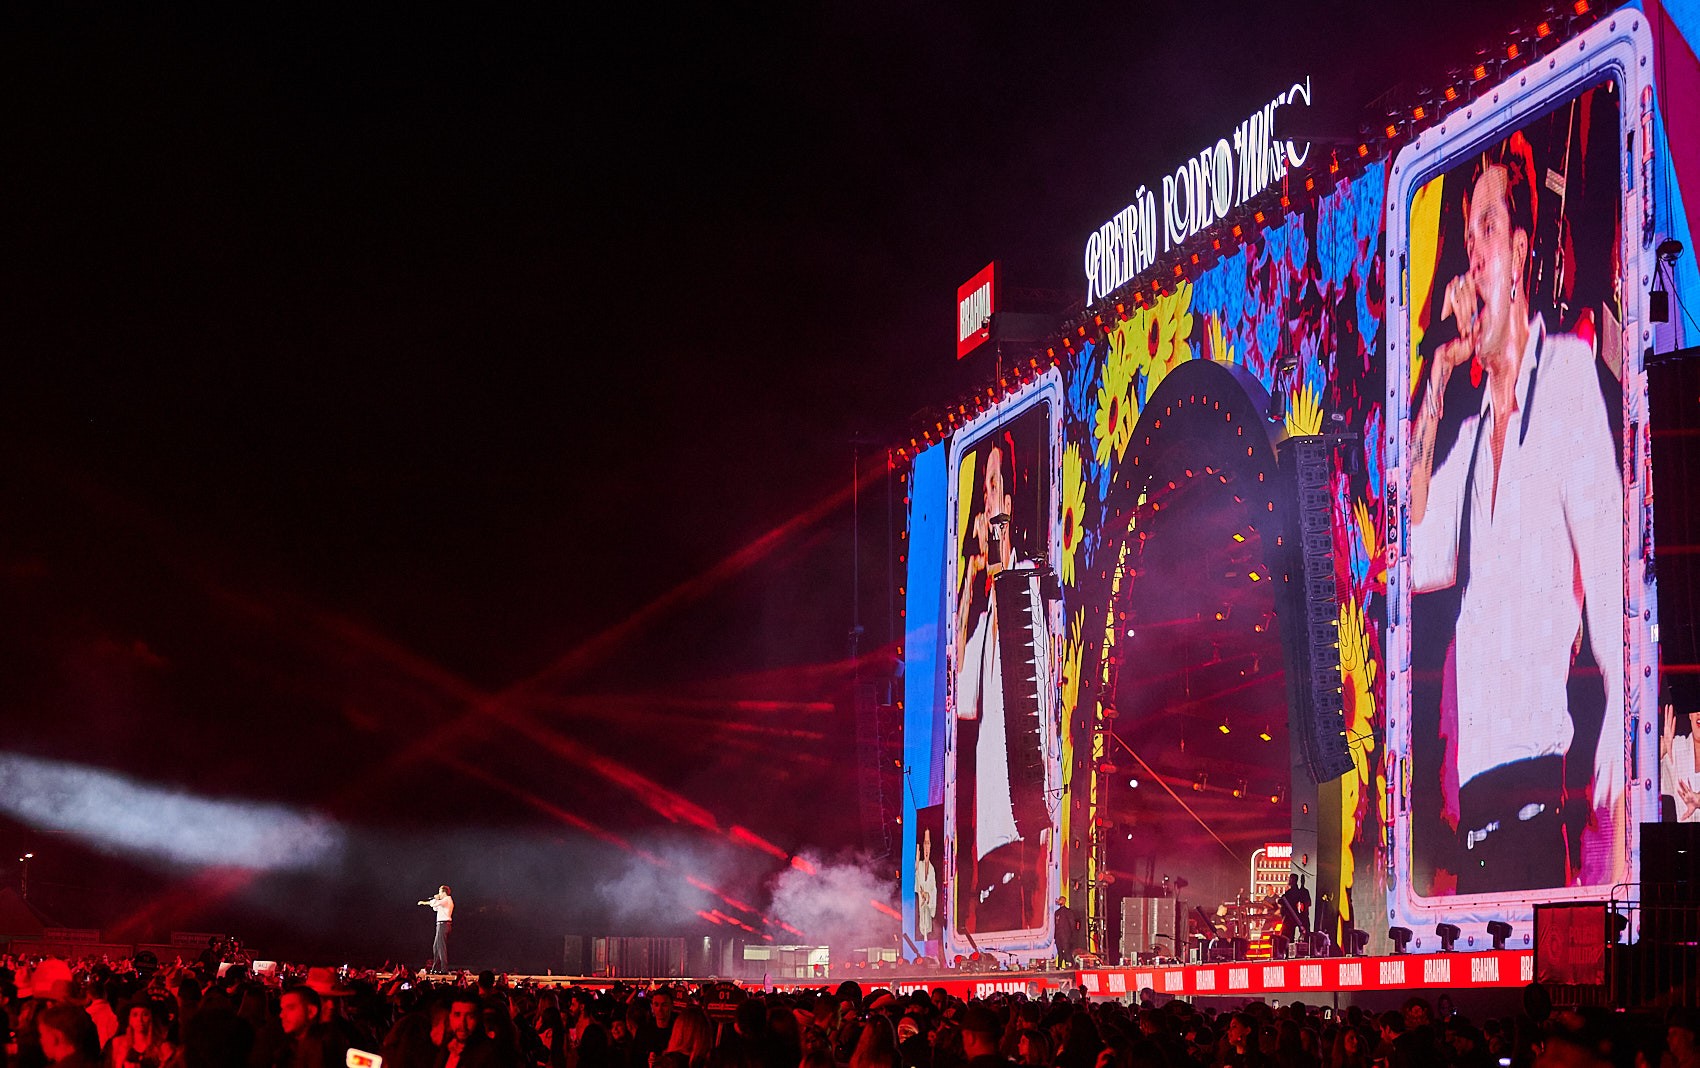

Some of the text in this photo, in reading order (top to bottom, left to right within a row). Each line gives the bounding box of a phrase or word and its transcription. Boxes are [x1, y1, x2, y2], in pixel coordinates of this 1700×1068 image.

[1085, 185, 1157, 307] RIBEIRÃO
[1162, 138, 1233, 253] RODEO
[959, 281, 992, 343] BRAHMA
[1266, 845, 1292, 857] BRAHM
[1339, 963, 1363, 986] BRAHMA
[1379, 961, 1406, 985] BRAHMA
[1424, 959, 1451, 983] BRAHMA
[1471, 957, 1500, 982] BRAHMA
[1520, 956, 1534, 982] BRA
[719, 991, 730, 1000] 01
[976, 982, 1026, 1000] BRAHM
